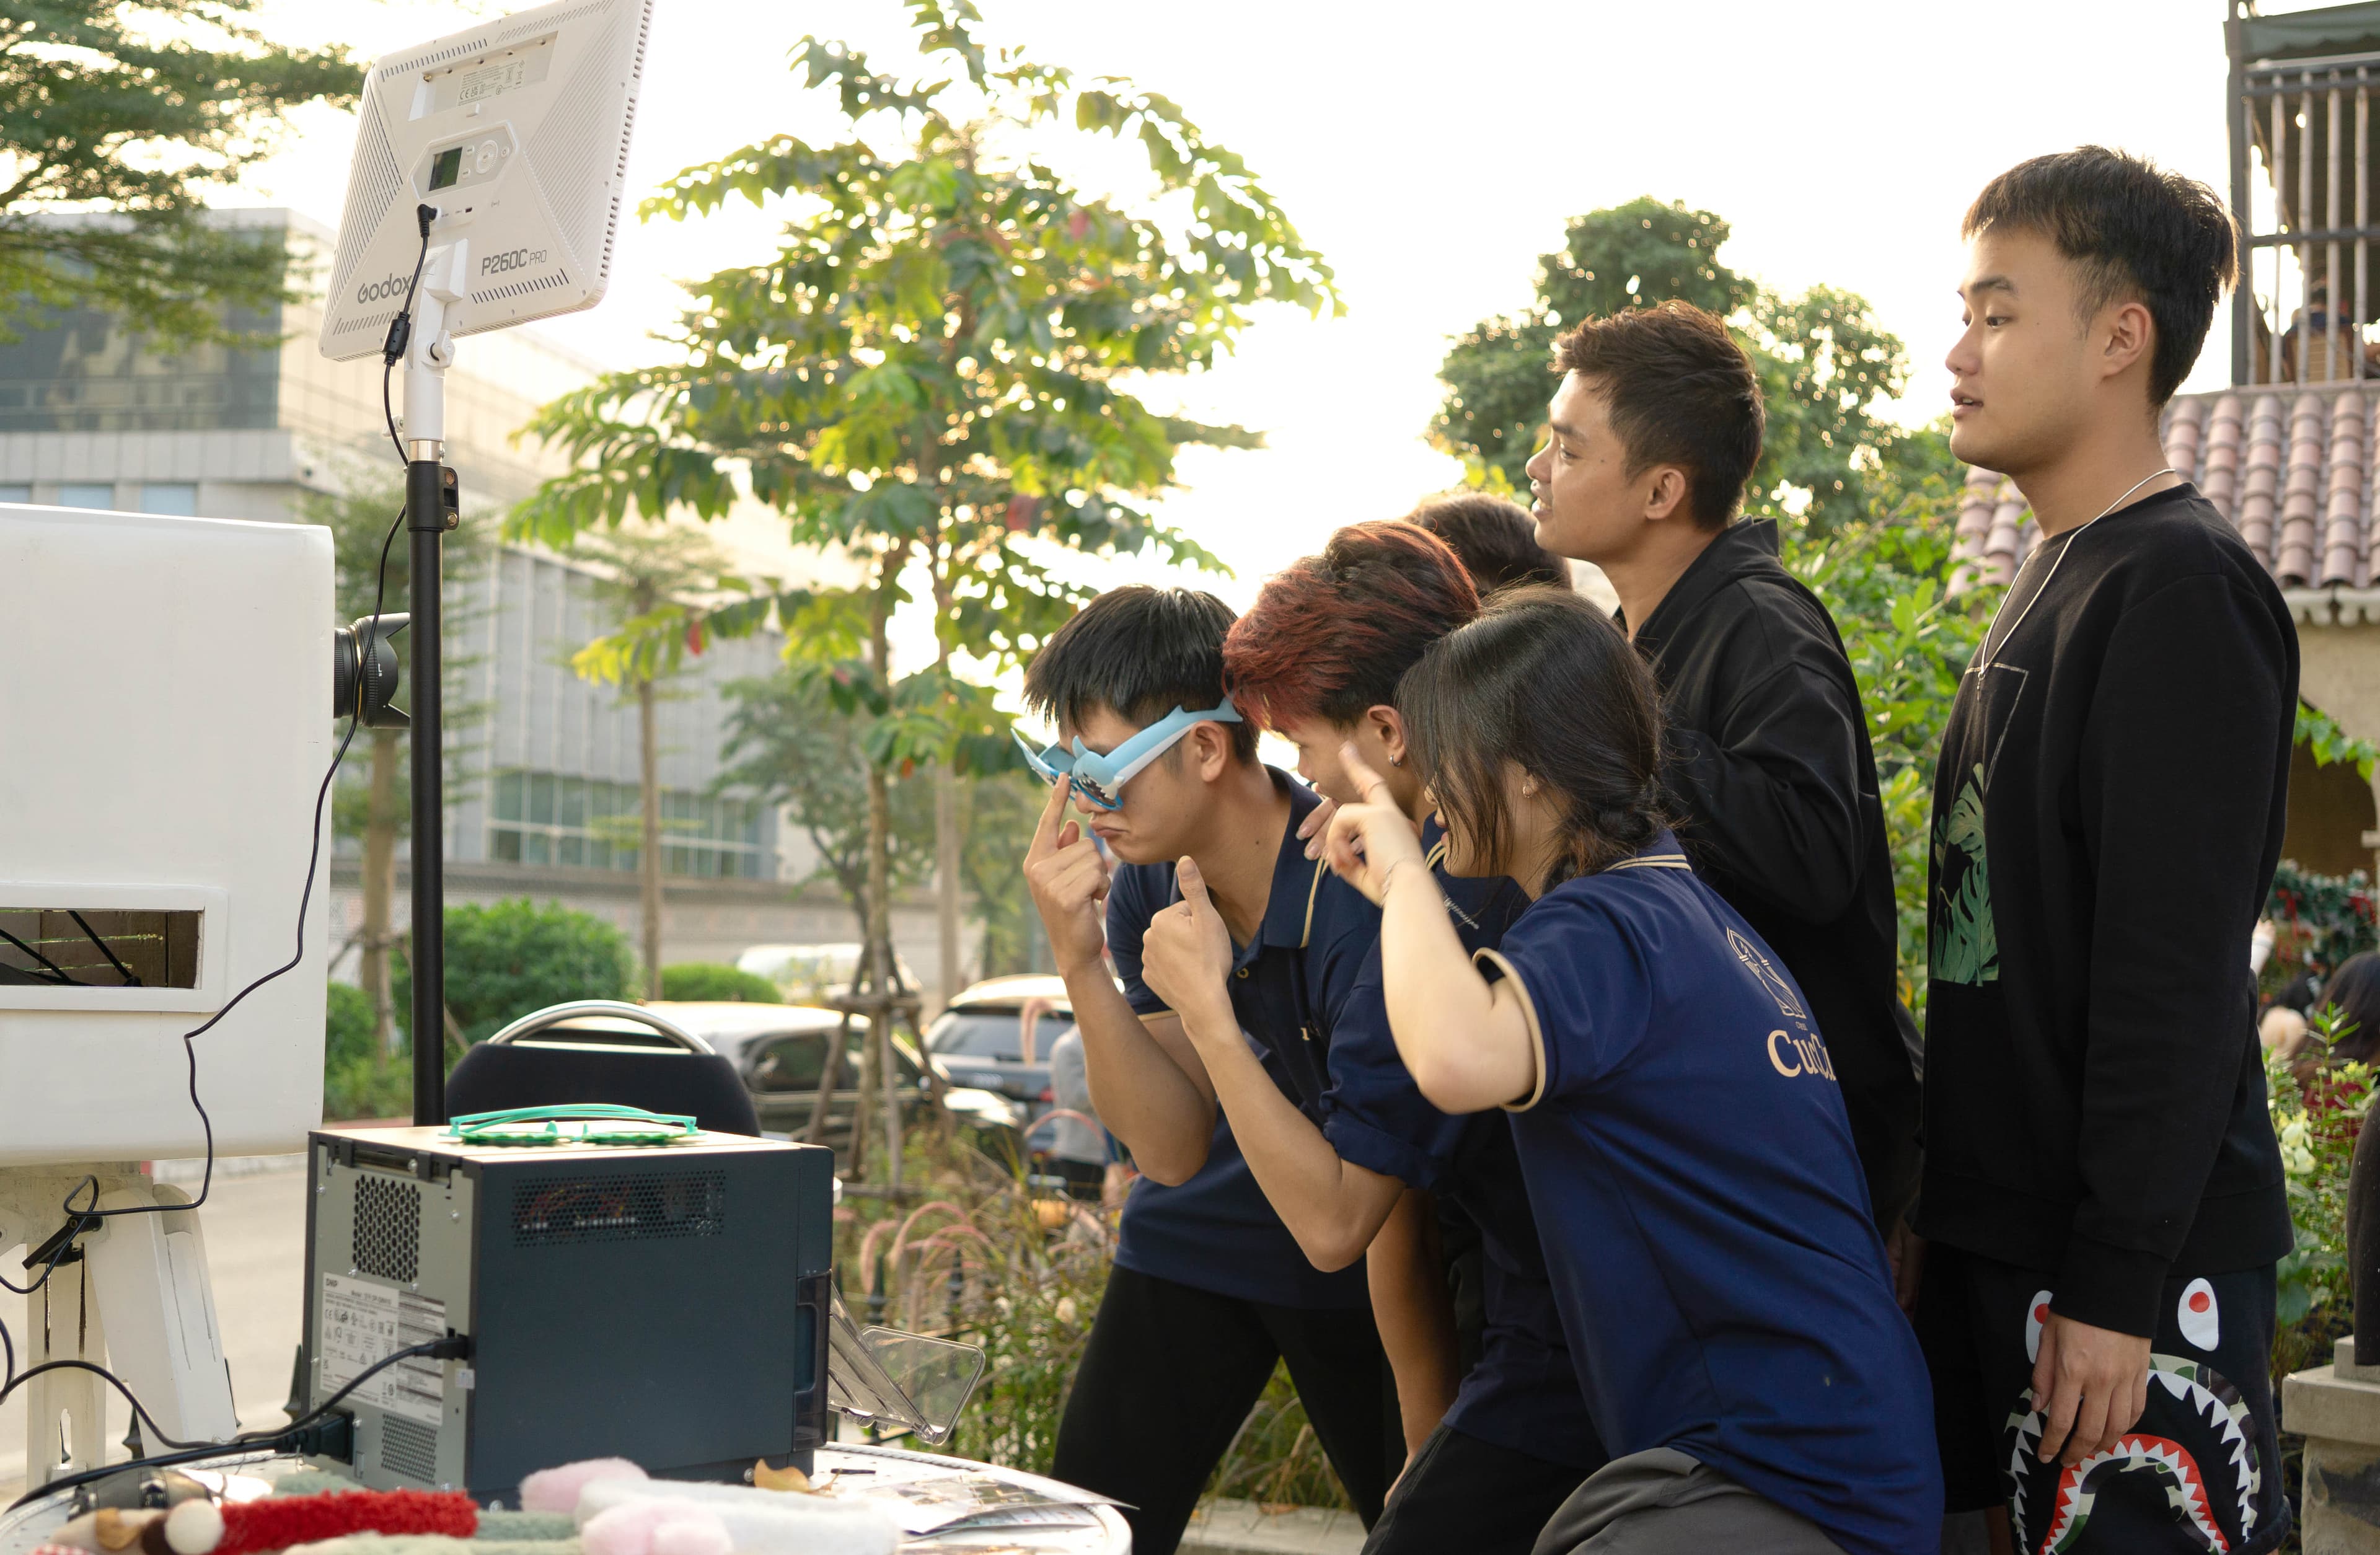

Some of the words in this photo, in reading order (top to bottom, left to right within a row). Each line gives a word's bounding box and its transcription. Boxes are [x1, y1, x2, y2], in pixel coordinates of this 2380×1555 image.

[482, 249, 527, 276] P260C
[529, 250, 547, 266] PRO
[357, 273, 414, 304] Godox
